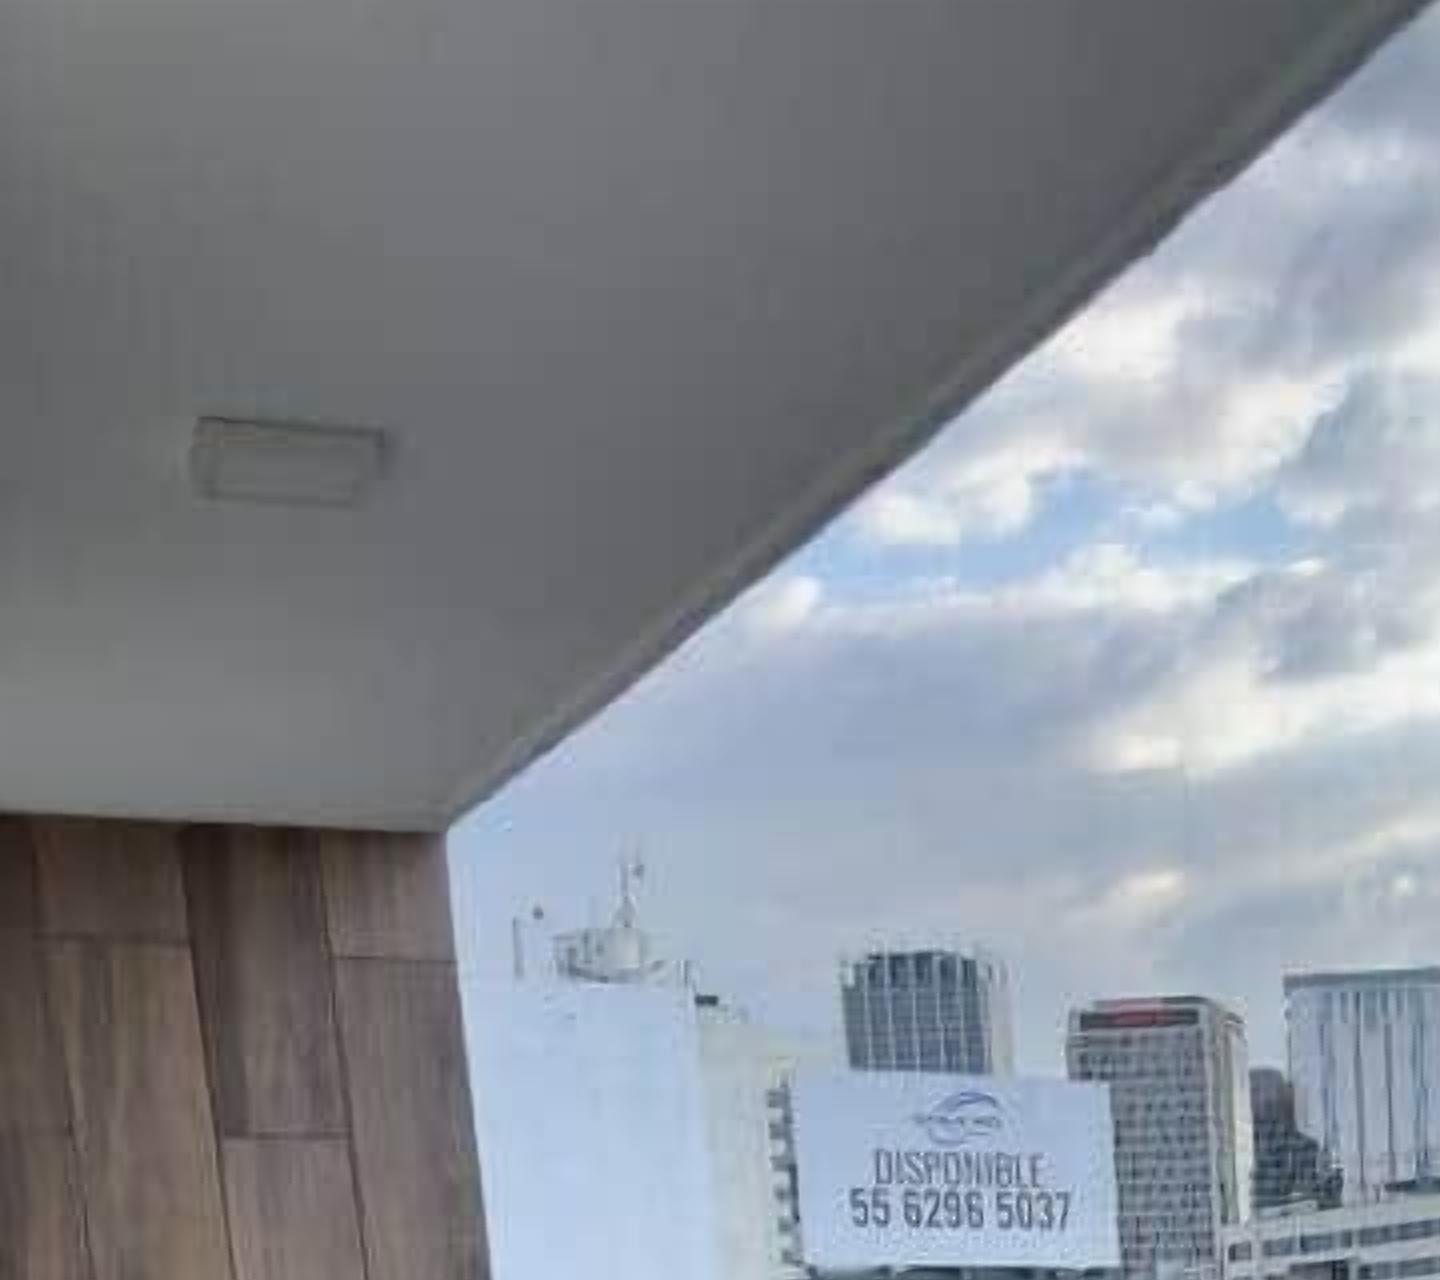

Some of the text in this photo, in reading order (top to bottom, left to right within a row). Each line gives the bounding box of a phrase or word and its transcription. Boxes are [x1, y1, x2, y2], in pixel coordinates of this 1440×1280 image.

[875, 1149, 1044, 1187] DISPONIBLE
[850, 1187, 1070, 1231] 55 6296 5037
